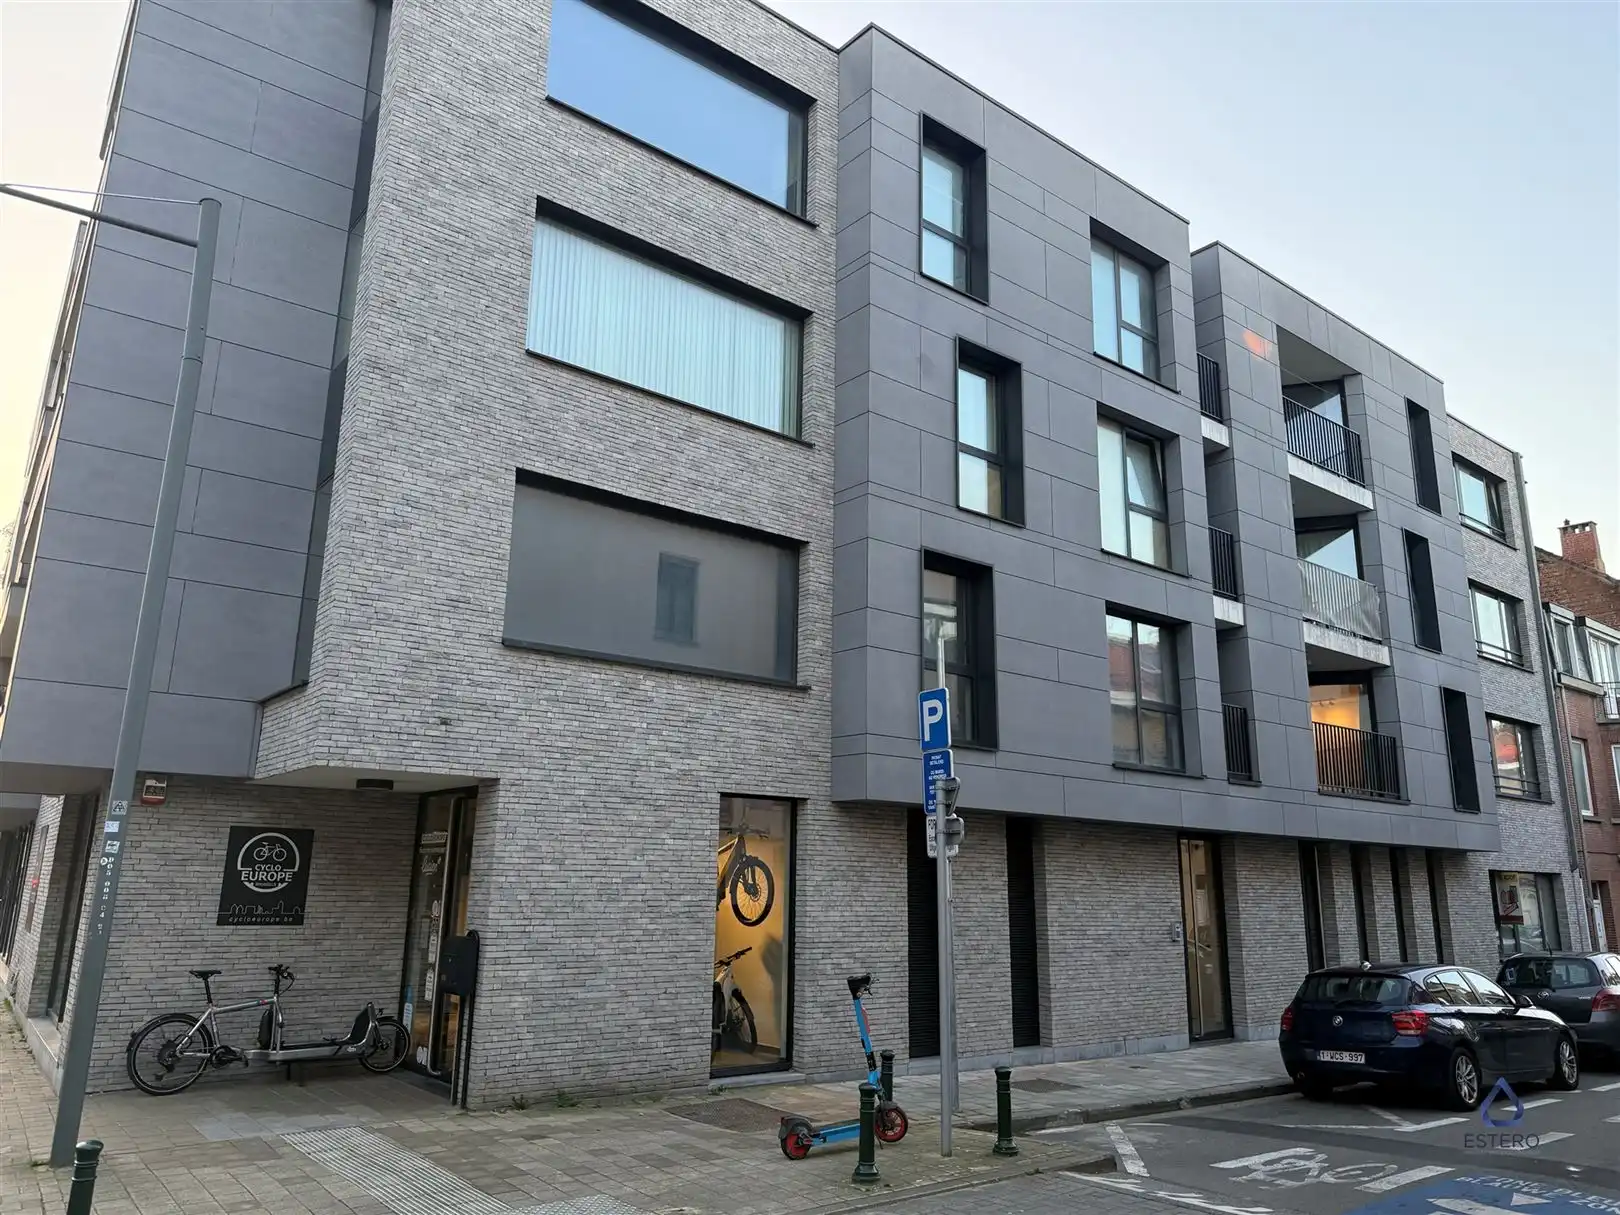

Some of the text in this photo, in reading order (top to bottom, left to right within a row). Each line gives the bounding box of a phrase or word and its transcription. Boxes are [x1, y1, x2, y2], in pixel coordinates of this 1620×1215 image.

[922, 699, 944, 742] P
[254, 863, 282, 872] CYCLO
[241, 871, 293, 882] EUROPE
